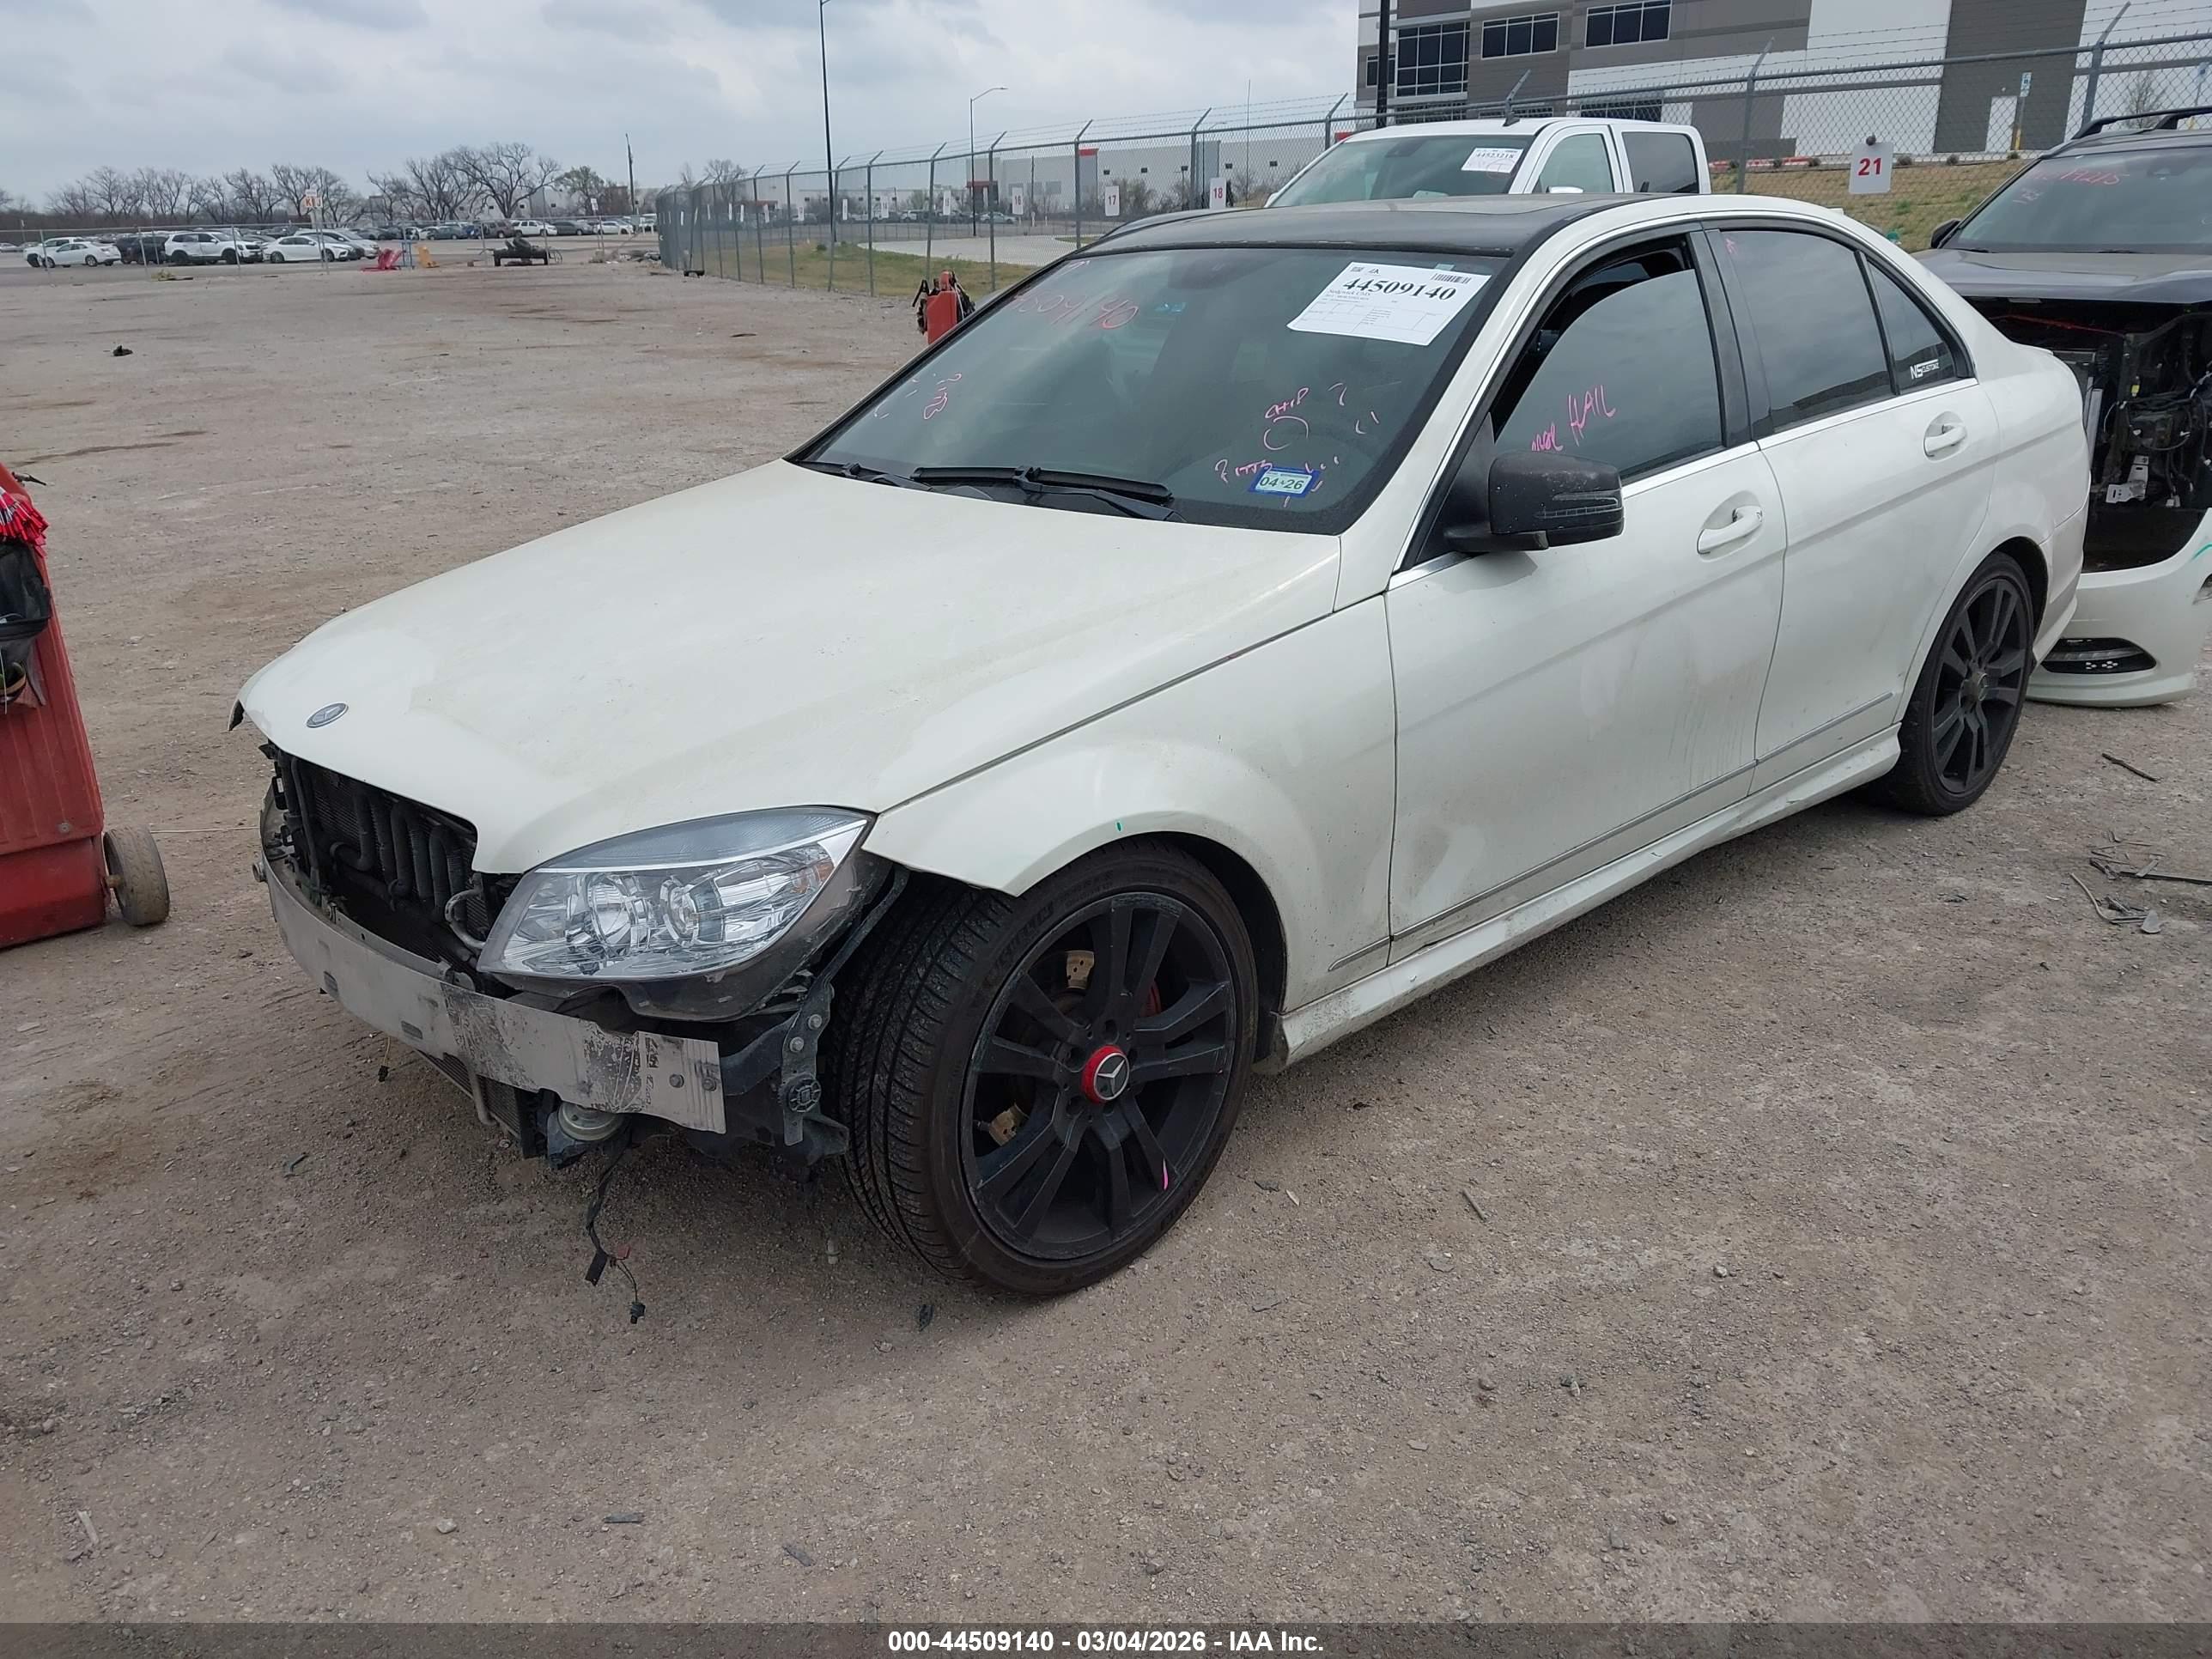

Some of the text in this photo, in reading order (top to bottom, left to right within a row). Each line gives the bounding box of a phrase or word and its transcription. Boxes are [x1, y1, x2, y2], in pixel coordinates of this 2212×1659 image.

[1857, 157, 1882, 176] 21
[1213, 186, 1224, 199] 18
[1014, 195, 1022, 206] 16
[1108, 194, 1116, 206] 17
[1342, 277, 1457, 301] 44509140
[1260, 477, 1304, 489] 04 26
